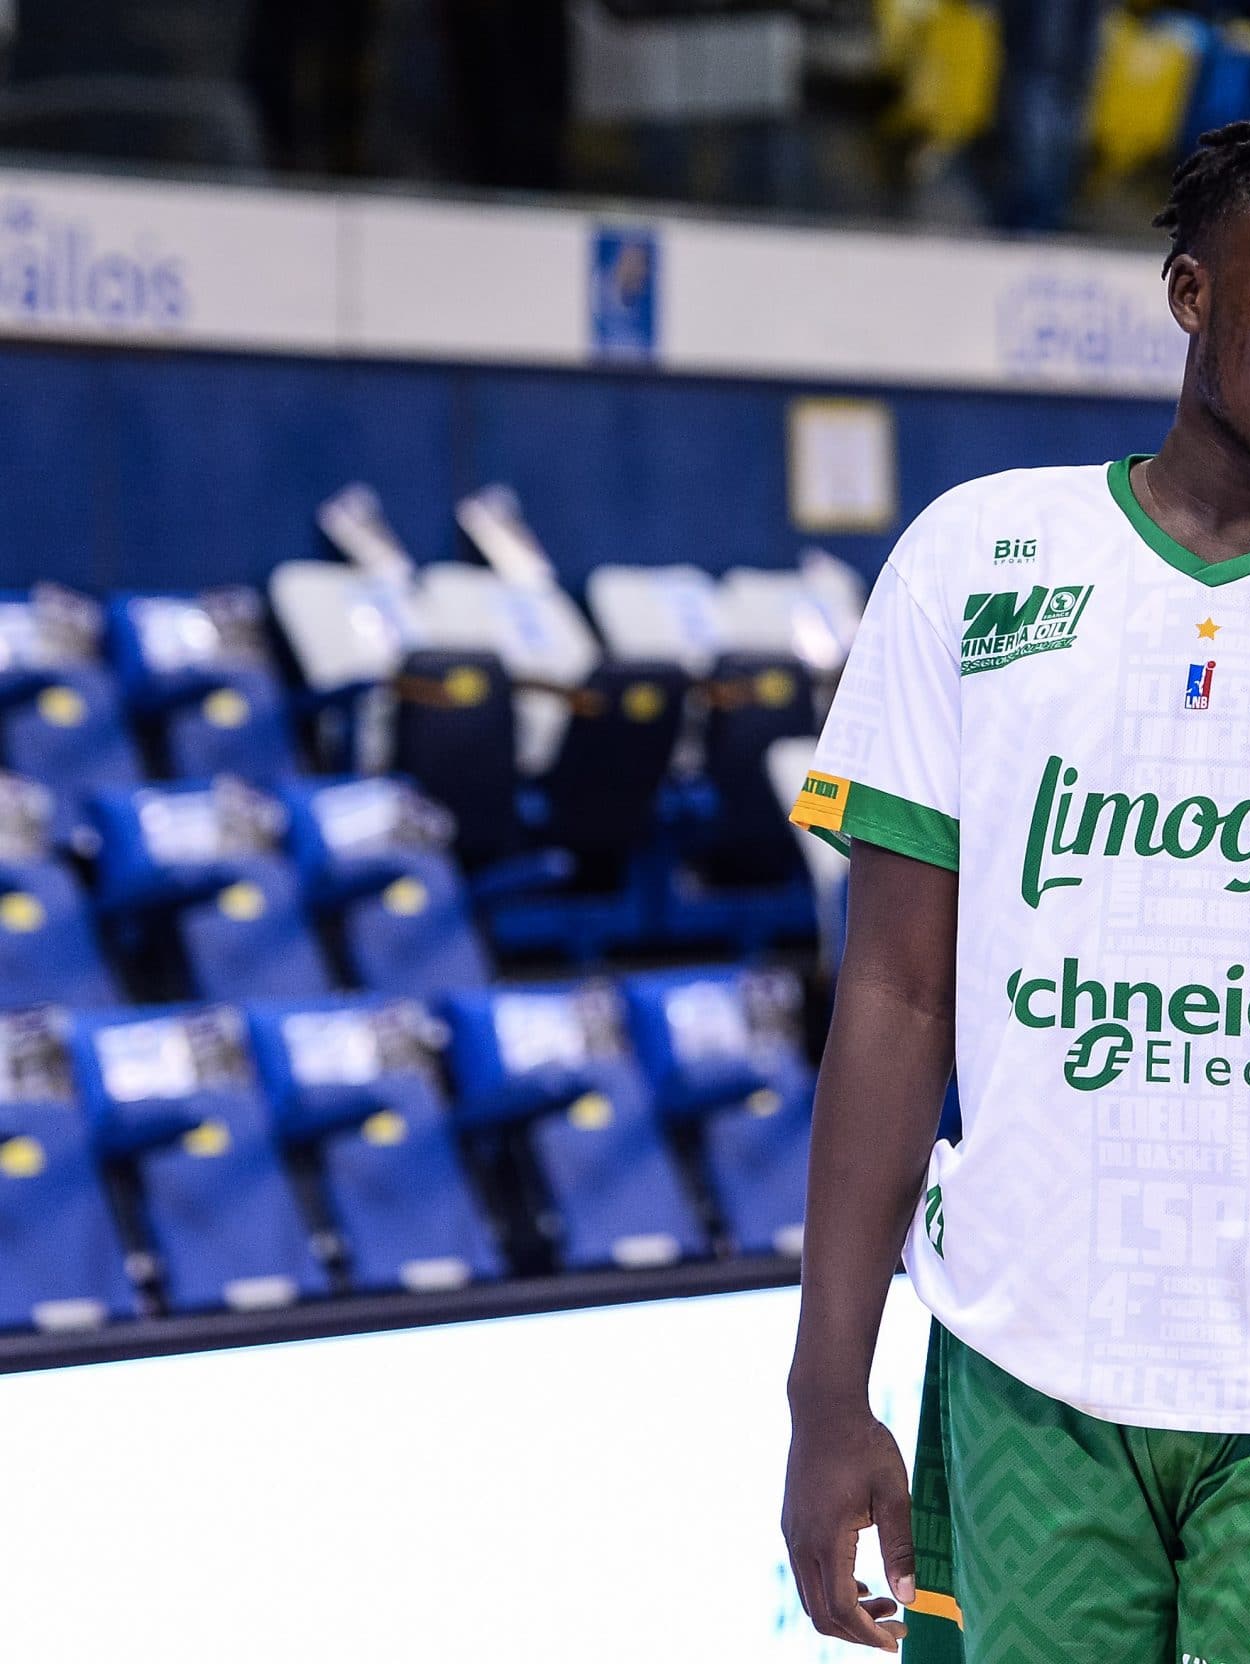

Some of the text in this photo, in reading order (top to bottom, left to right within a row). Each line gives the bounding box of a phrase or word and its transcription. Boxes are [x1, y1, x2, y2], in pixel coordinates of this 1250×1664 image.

[961, 626, 1029, 659] MINERA
[1034, 621, 1068, 641] OIL
[1185, 695, 1208, 709] LNB
